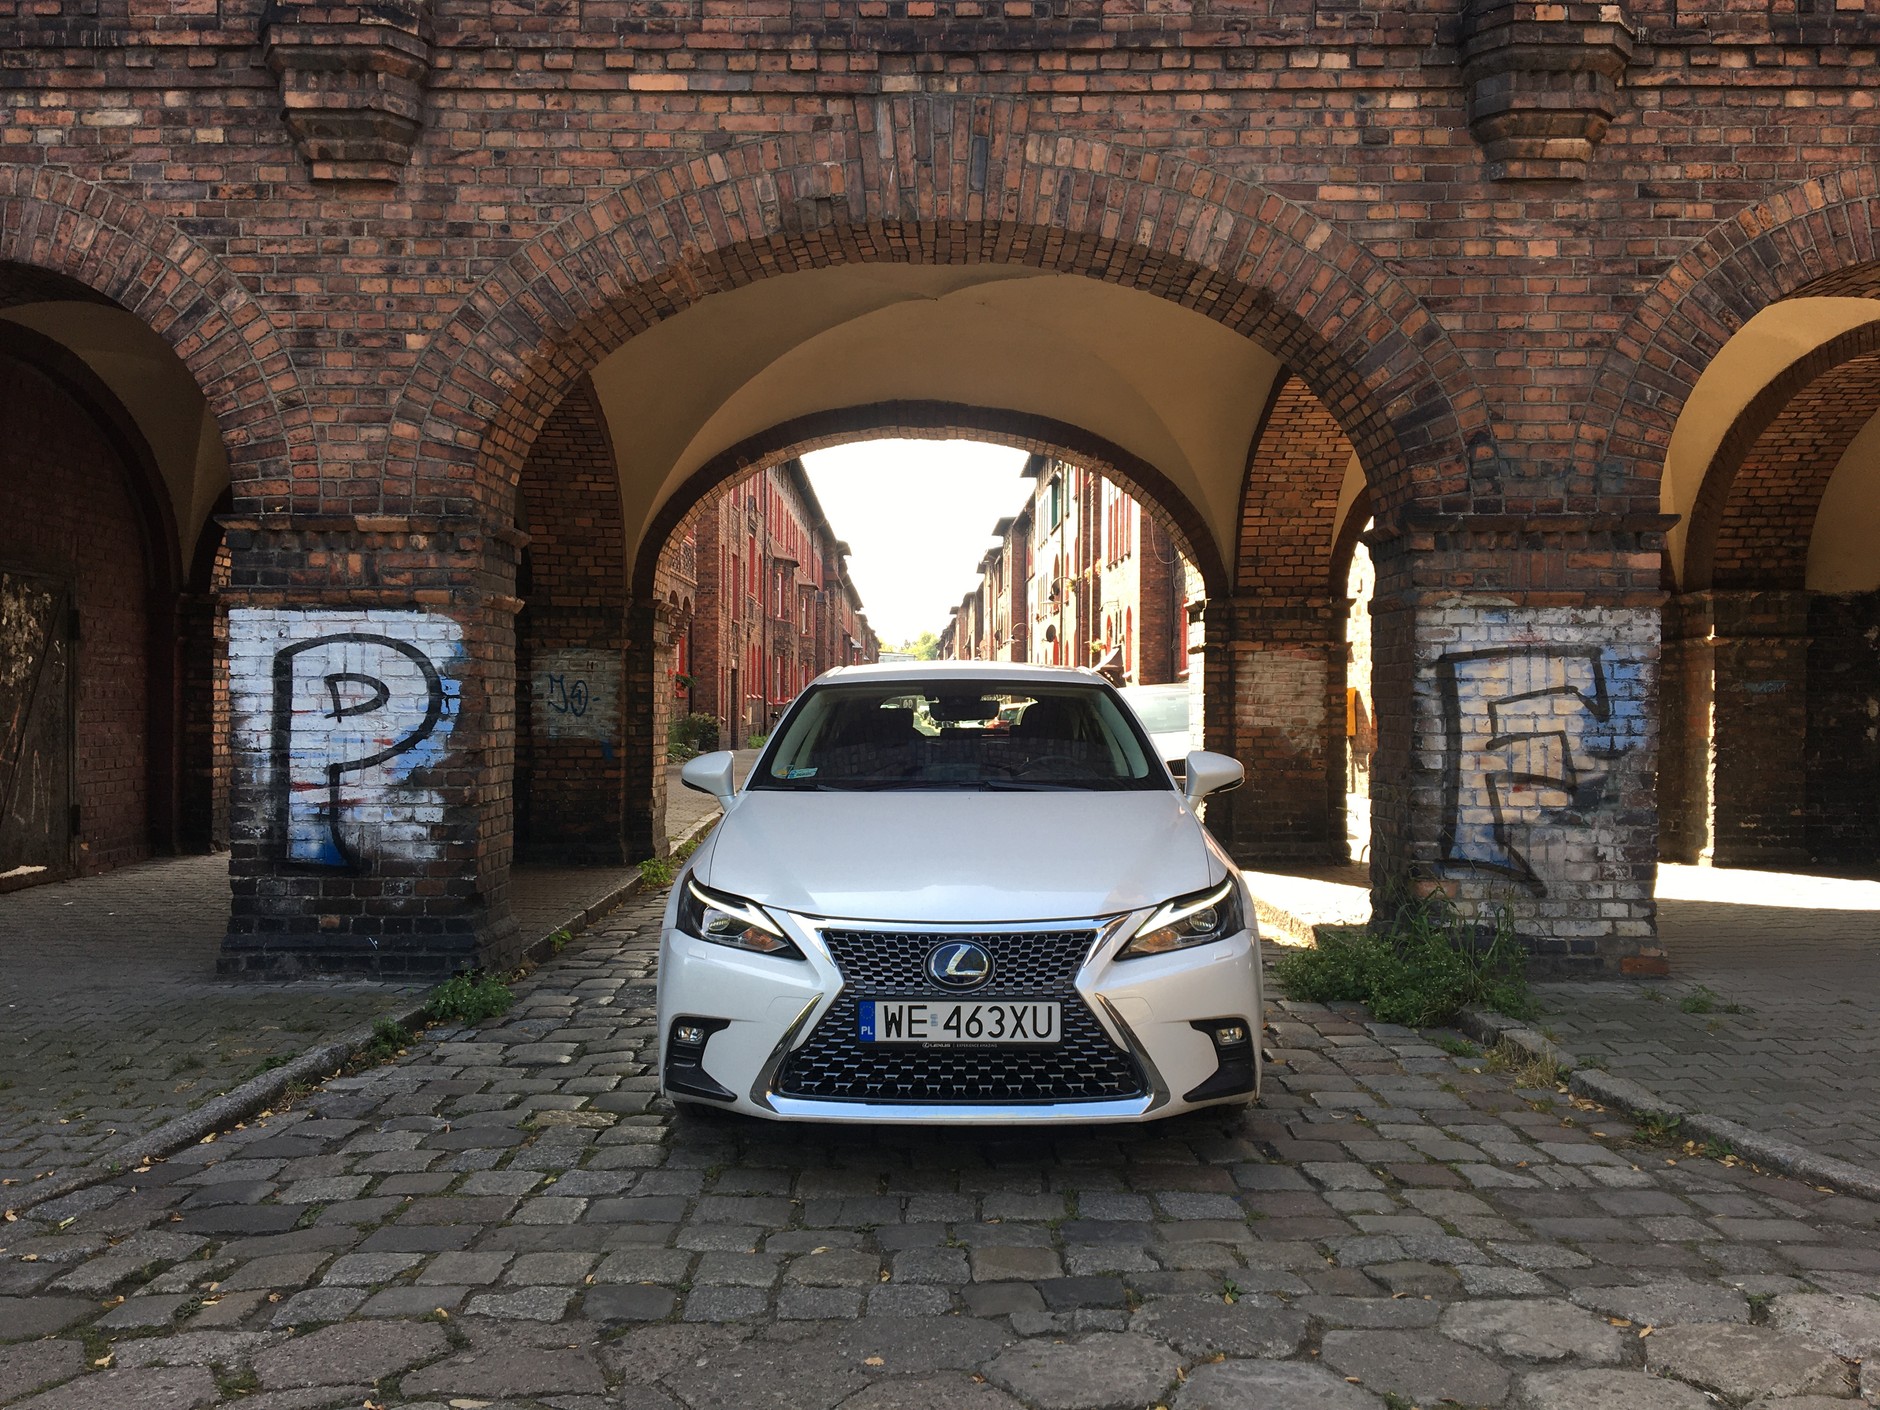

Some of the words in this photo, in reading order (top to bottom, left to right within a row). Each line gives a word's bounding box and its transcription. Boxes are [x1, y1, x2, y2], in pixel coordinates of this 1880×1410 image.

[861, 1025, 873, 1036] PL
[883, 1005, 928, 1038] WE
[943, 1005, 1053, 1039] 463XU
